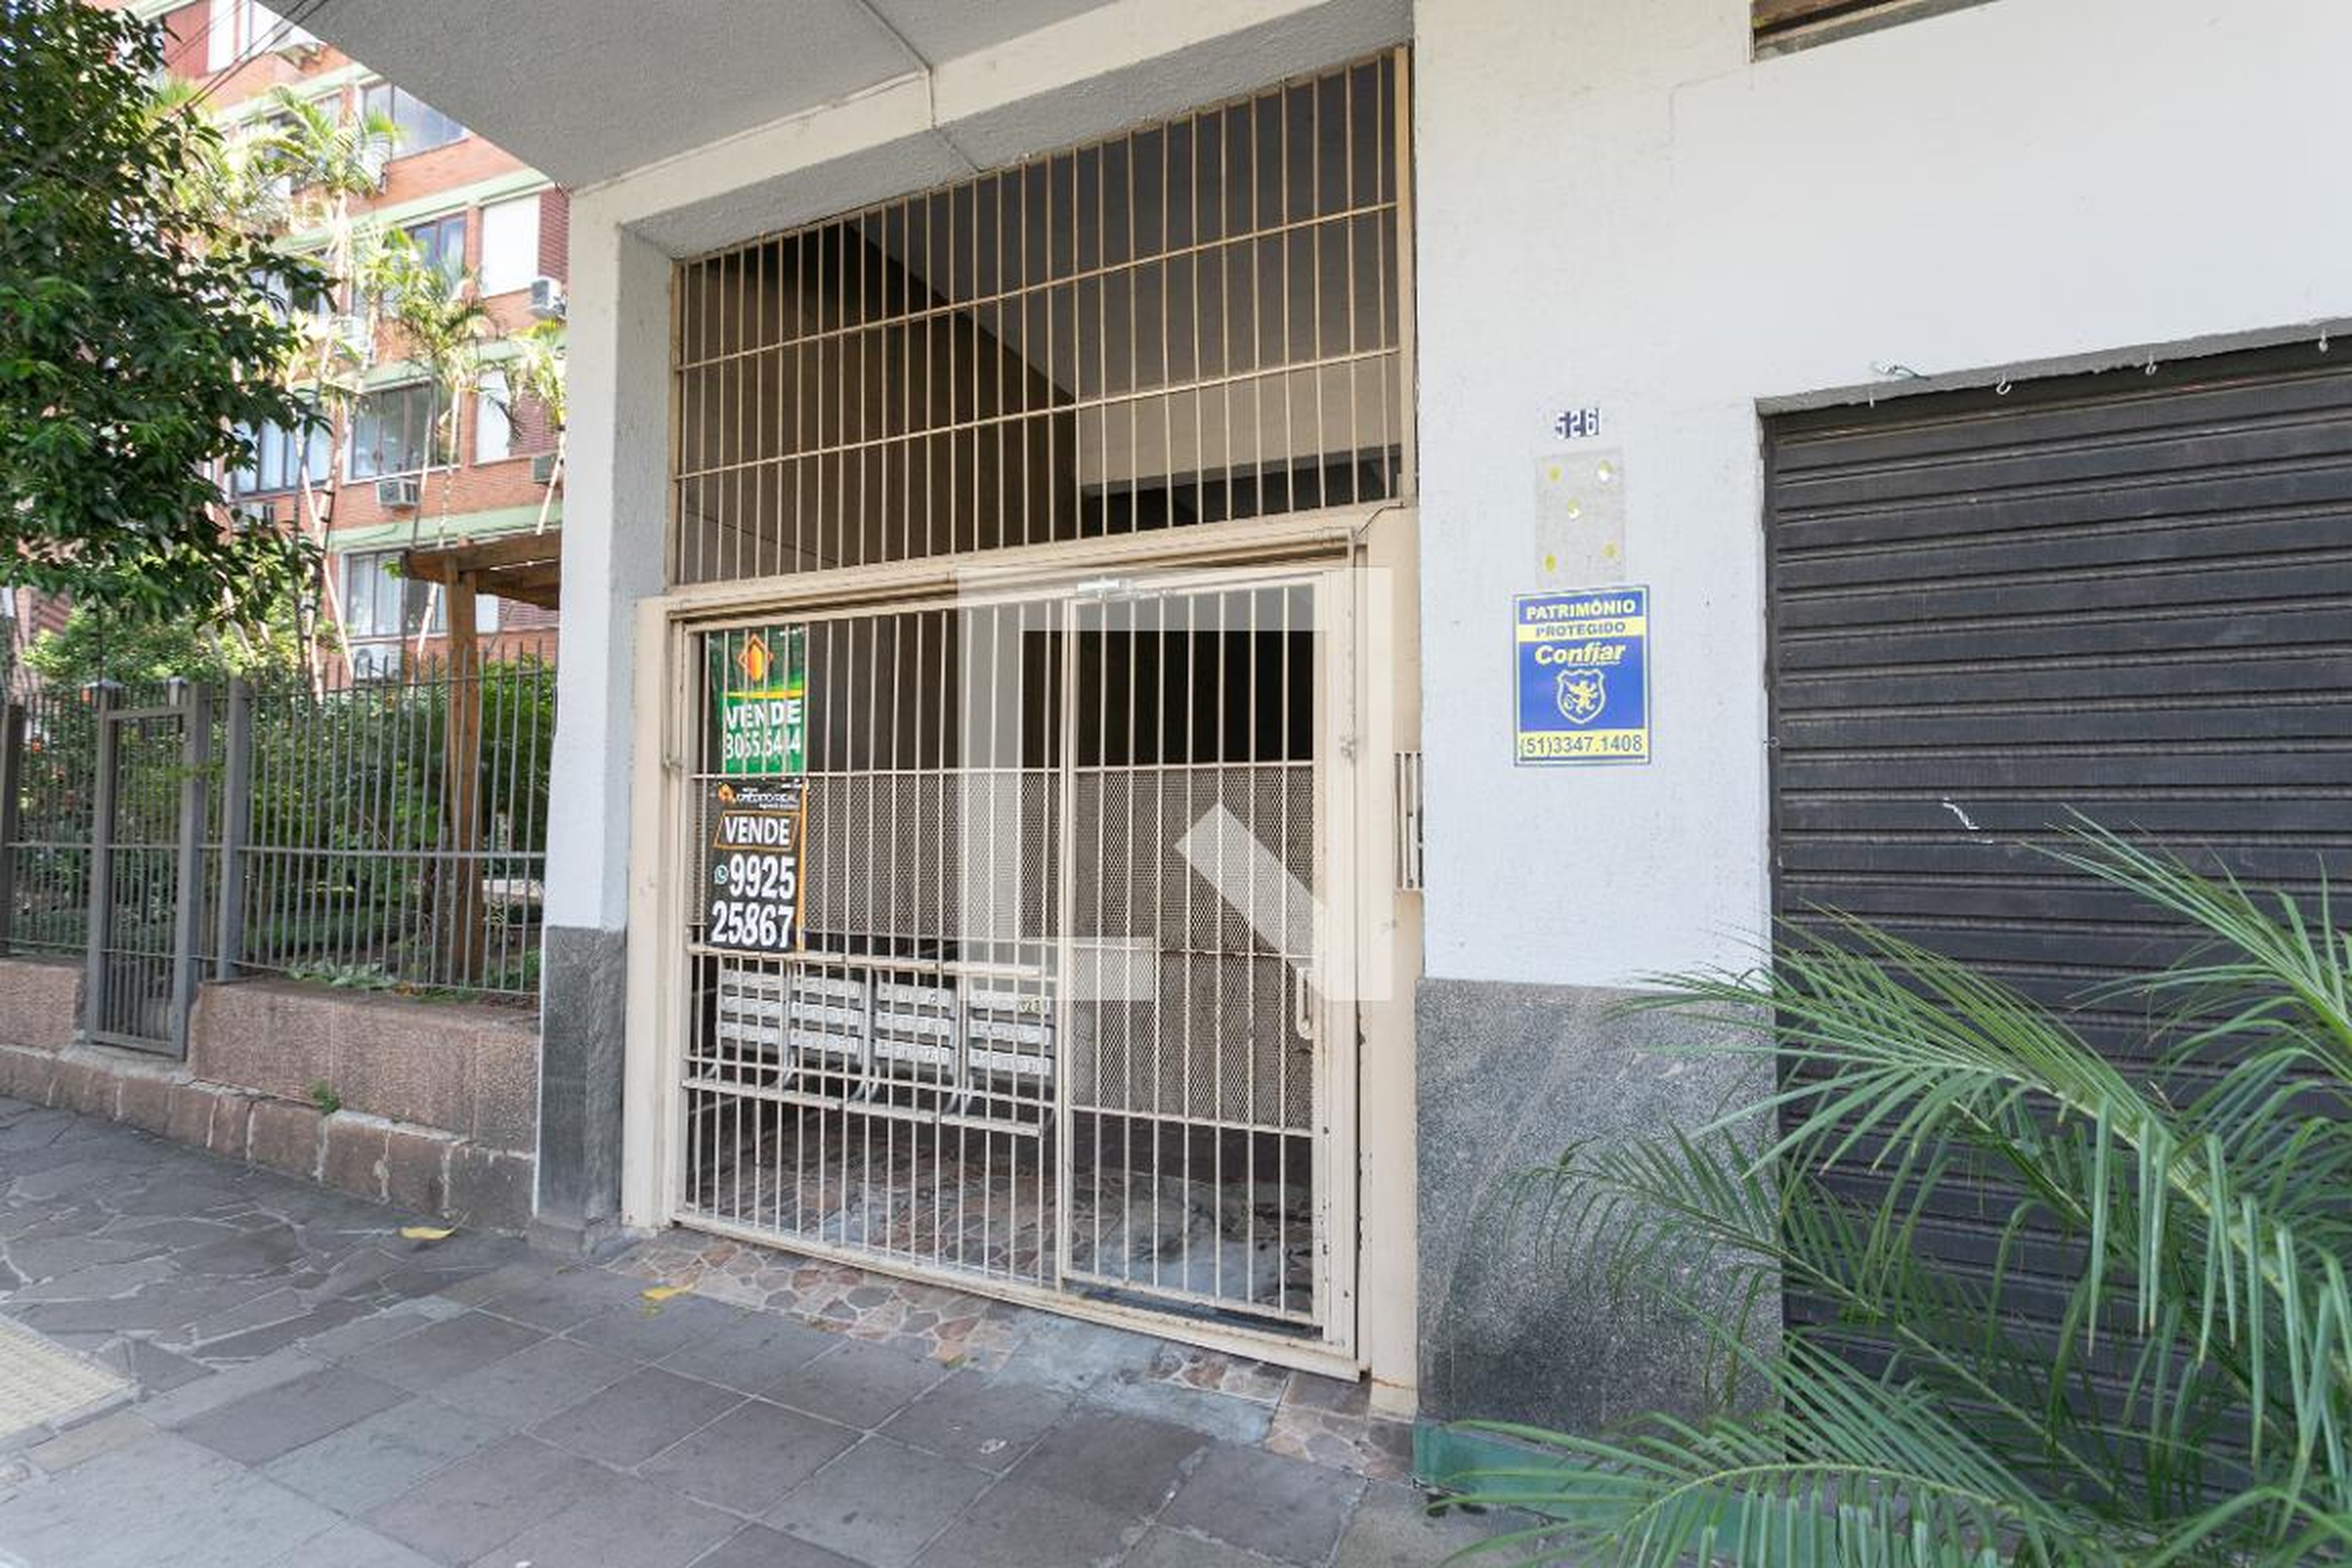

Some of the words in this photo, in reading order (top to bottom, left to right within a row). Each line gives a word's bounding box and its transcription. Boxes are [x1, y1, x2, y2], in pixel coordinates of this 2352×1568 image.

[1536, 622, 1626, 636] PROTEGIDO
[1534, 642, 1626, 665] Confiar
[725, 702, 801, 728] VENDE
[1519, 734, 1643, 757] (51)3347.1408
[725, 816, 790, 845] VENDE
[729, 853, 796, 899] 9925
[711, 901, 794, 948] 25867
